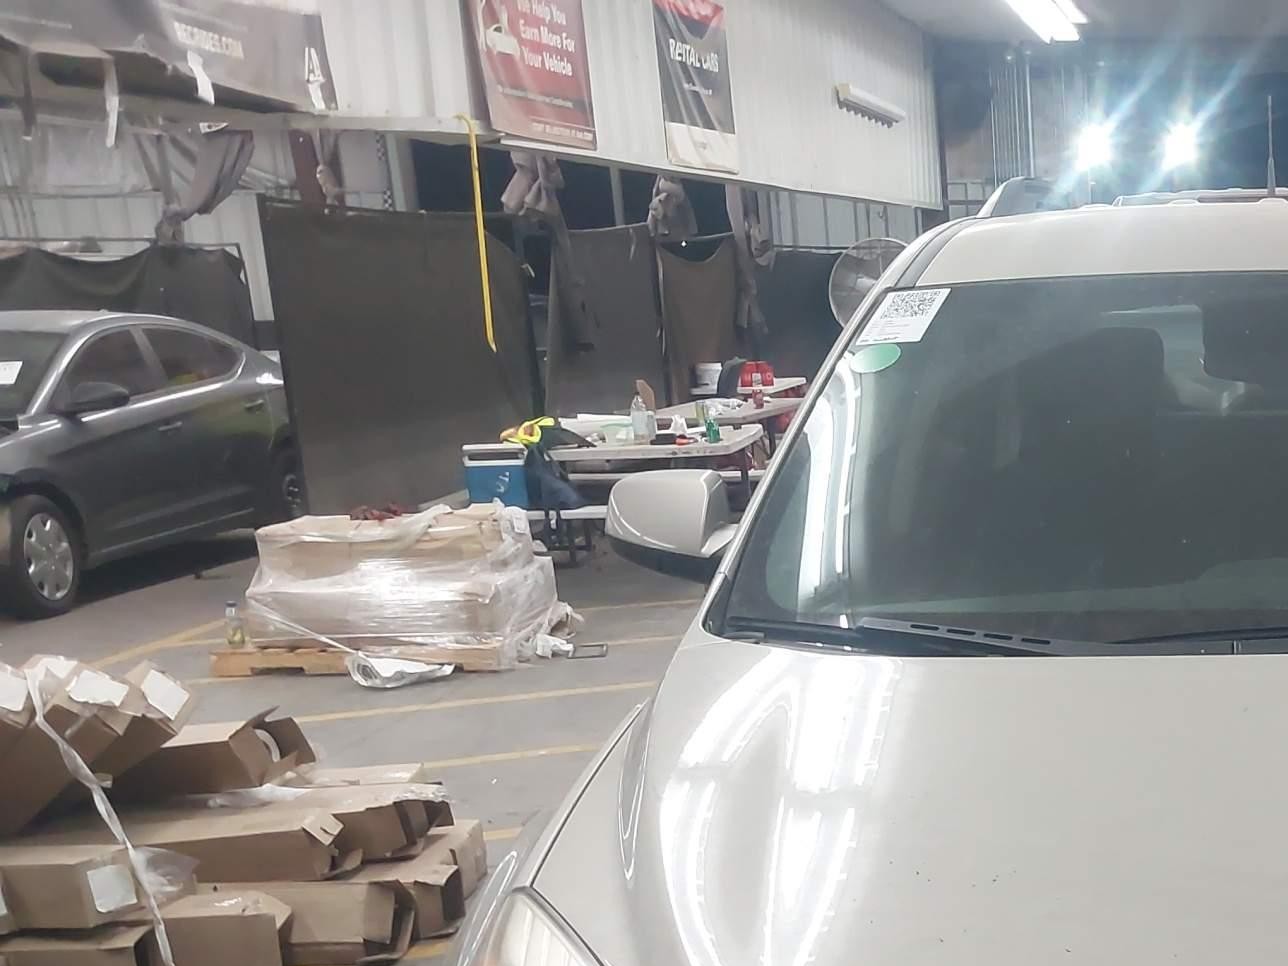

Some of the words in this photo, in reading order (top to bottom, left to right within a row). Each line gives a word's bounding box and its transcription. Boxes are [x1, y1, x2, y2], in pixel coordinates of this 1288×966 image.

[519, 19, 540, 42] Earn
[540, 25, 561, 49] More
[561, 32, 576, 53] For
[520, 46, 542, 68] Your
[542, 51, 573, 76] Vehicle
